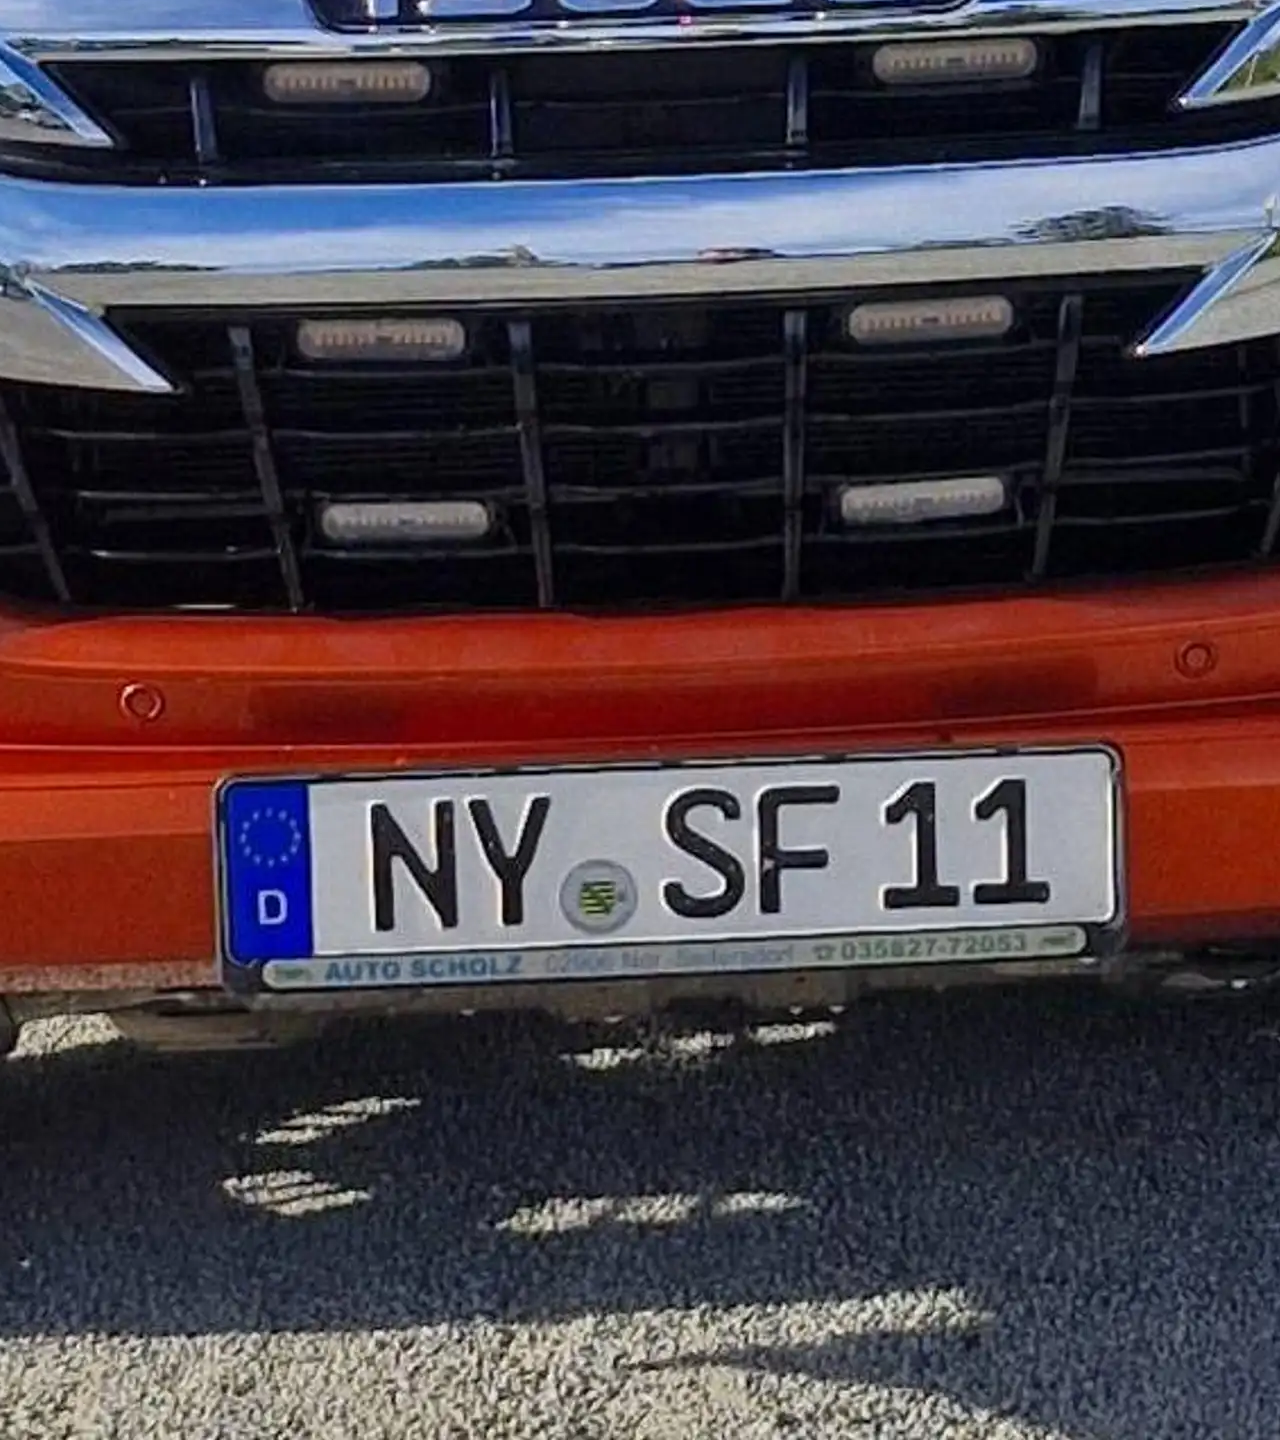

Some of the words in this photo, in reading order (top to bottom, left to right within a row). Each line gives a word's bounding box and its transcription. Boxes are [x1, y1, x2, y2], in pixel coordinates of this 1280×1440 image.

[369, 794, 551, 932] NY
[662, 784, 841, 919] SF
[882, 778, 1051, 910] 11
[257, 889, 289, 926] D
[324, 958, 401, 981] AUTO
[408, 954, 523, 979] SCHOLZ
